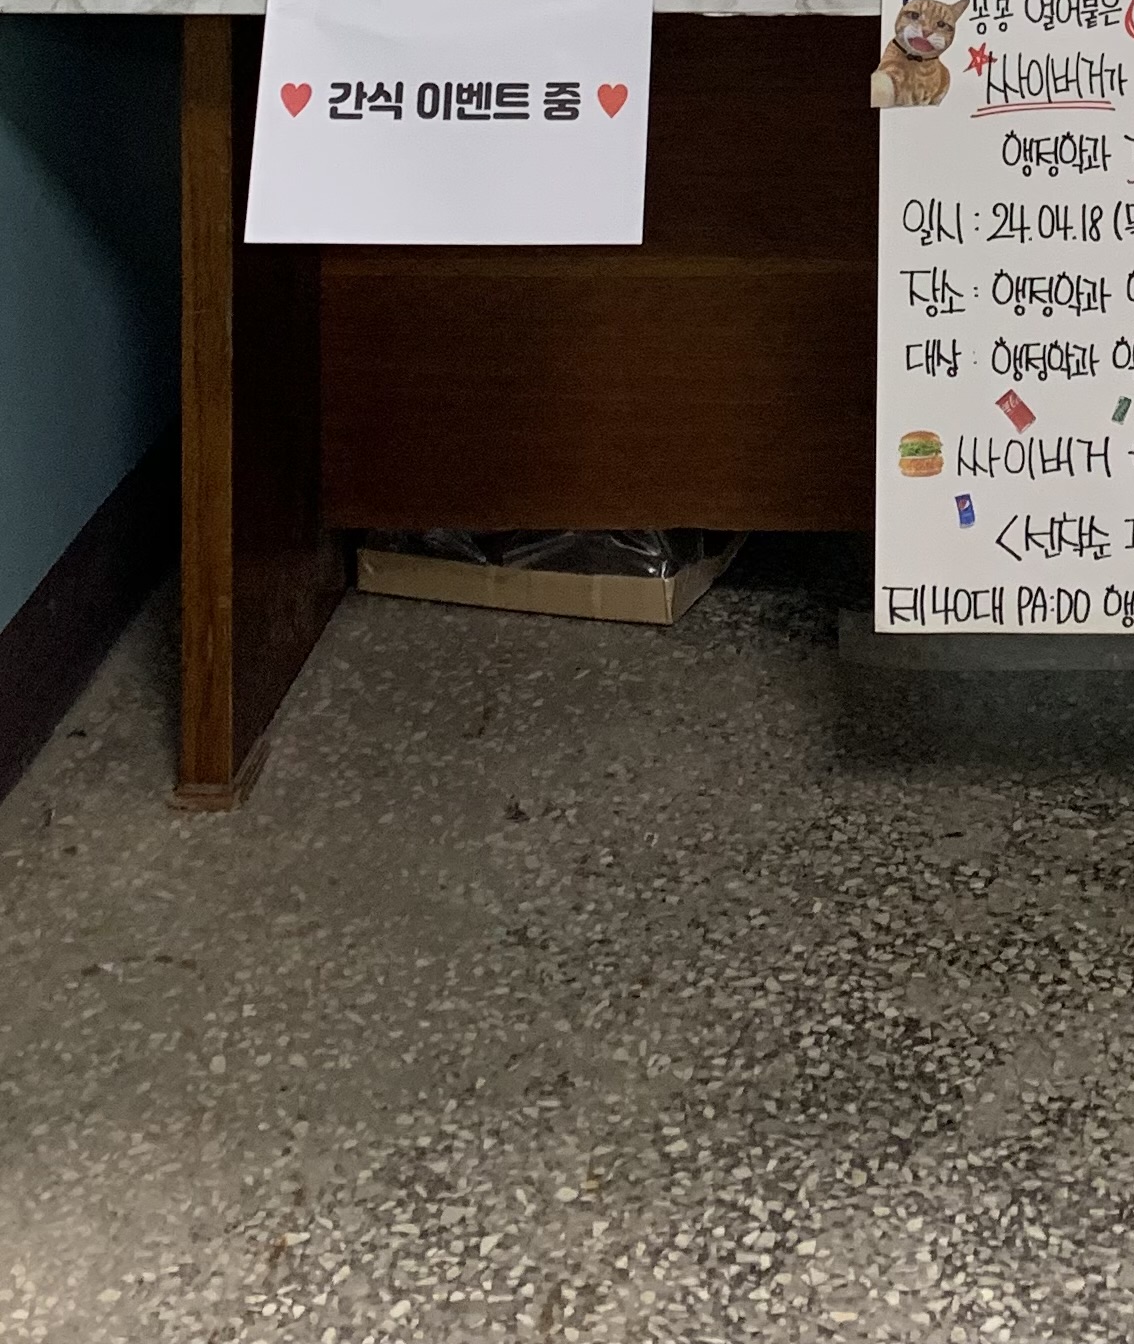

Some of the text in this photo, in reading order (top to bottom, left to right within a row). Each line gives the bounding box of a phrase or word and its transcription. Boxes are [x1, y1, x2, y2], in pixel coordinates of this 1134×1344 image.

[328, 81, 581, 121] 간식 이벤트 중
[1002, 129, 1112, 178] 행정학과
[903, 197, 963, 245] 일시
[986, 202, 1104, 244] 24.04.18
[900, 266, 966, 314] 장소
[991, 268, 1112, 315] 행정학과
[905, 338, 962, 378] 대상
[991, 336, 1100, 381] 행정학과
[957, 434, 1112, 479] 싸이버거
[1017, 585, 1091, 626] PA:DO
